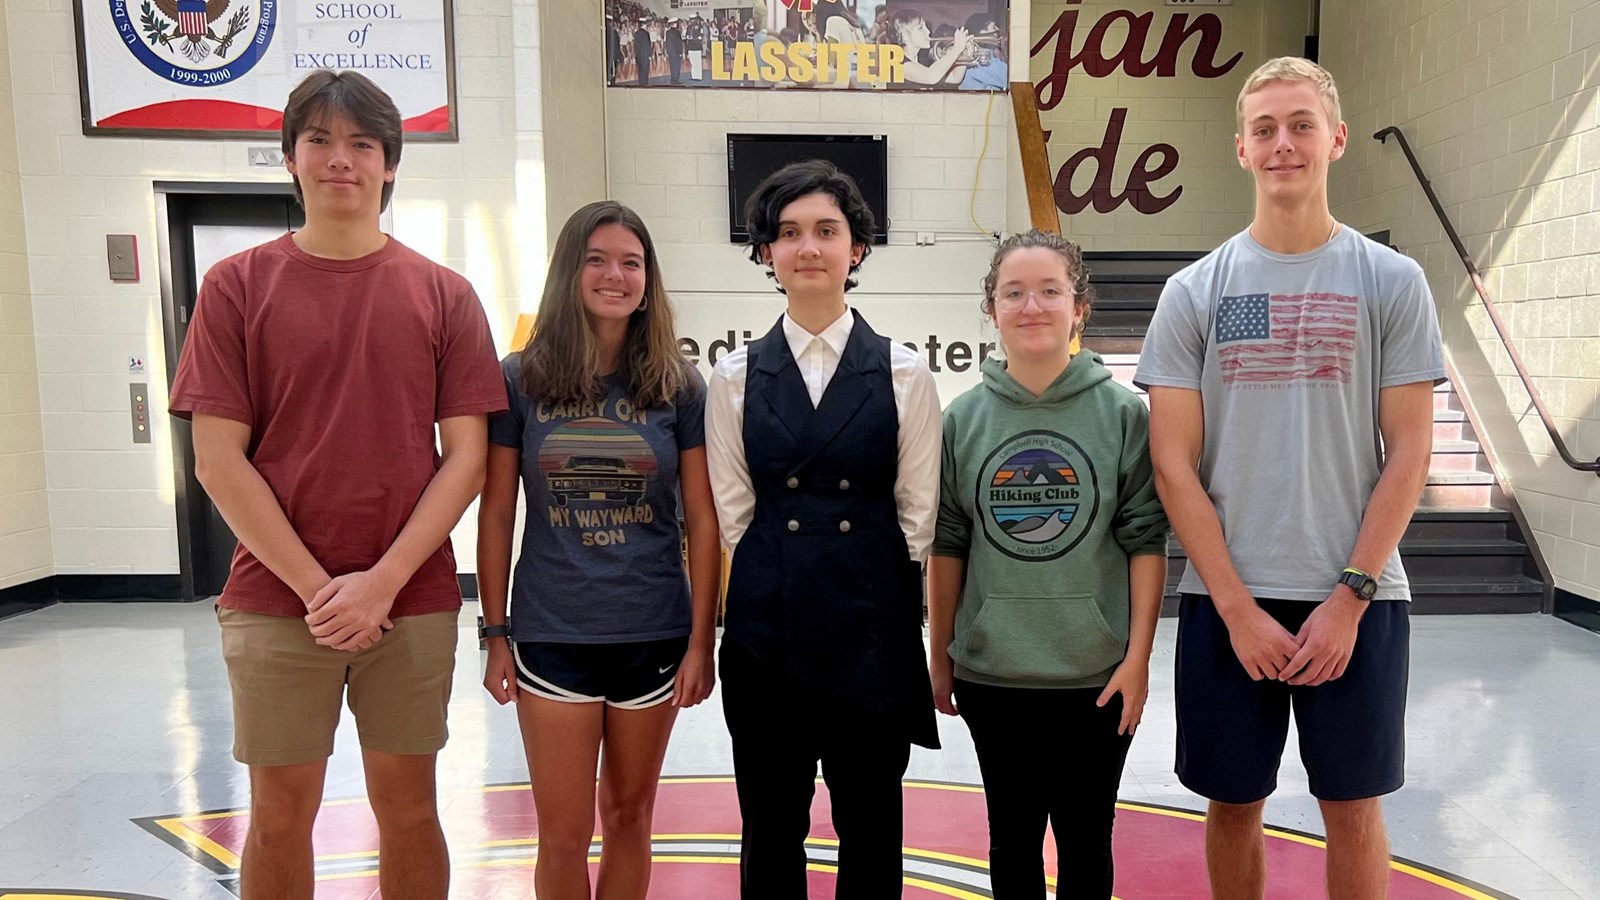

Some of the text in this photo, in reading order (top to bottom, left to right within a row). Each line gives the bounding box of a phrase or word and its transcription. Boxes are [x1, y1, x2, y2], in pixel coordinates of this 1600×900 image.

[115, 0, 137, 44] U.S. De
[256, 1, 273, 45] Program
[315, 3, 402, 19] SCHOOL
[348, 23, 372, 48] of
[294, 54, 432, 69] EXCELLENCE
[711, 41, 905, 84] LASSITER
[170, 68, 231, 84] 1999-2000
[1044, 108, 1183, 215] de
[902, 335, 996, 372] ter
[536, 398, 647, 425] CARRY ON
[999, 438, 1073, 459] Campbell High School
[989, 488, 1080, 503] Hiking Club
[548, 504, 653, 528] MY WAYWARD
[582, 528, 626, 546] SON
